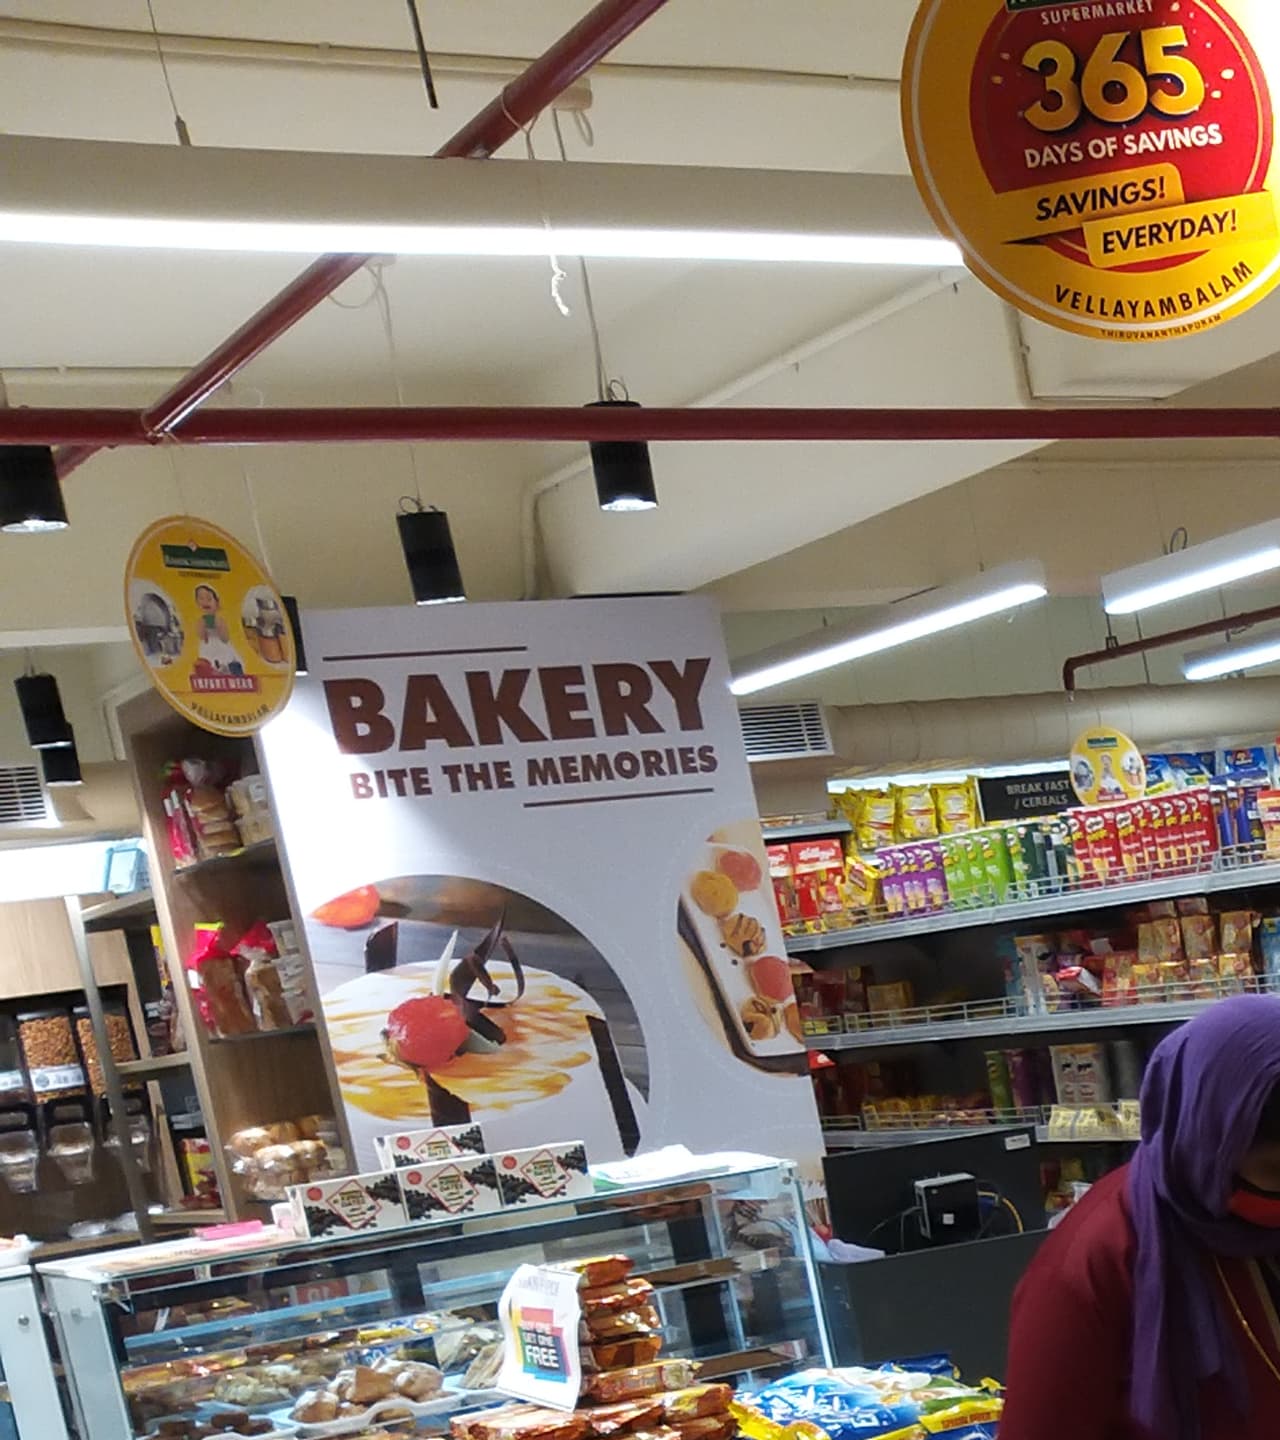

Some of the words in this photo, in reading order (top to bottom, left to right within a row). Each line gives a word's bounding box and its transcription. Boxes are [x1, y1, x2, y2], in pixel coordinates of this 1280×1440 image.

[1041, 0, 1153, 25] SUPERMARKET
[1021, 25, 1206, 132] 365
[1024, 143, 1084, 169] DAYS
[1088, 137, 1118, 158] OF
[1124, 124, 1223, 155] SAVINGS
[1035, 176, 1166, 221] SAVINGS!
[1102, 209, 1238, 254] EVERYDAY!
[1054, 261, 1253, 319] VELLAYAMBALAM
[1101, 314, 1222, 340] THIRUVANANTHAPURAM
[321, 657, 712, 756] BAKERY
[349, 766, 433, 799] BITE
[441, 760, 515, 793] THE
[526, 745, 719, 788] MEMORIES
[1006, 781, 1043, 795] BREAK
[1045, 779, 1071, 792] FAST
[1022, 794, 1068, 808] CEREALS
[524, 1344, 560, 1368] FREE
